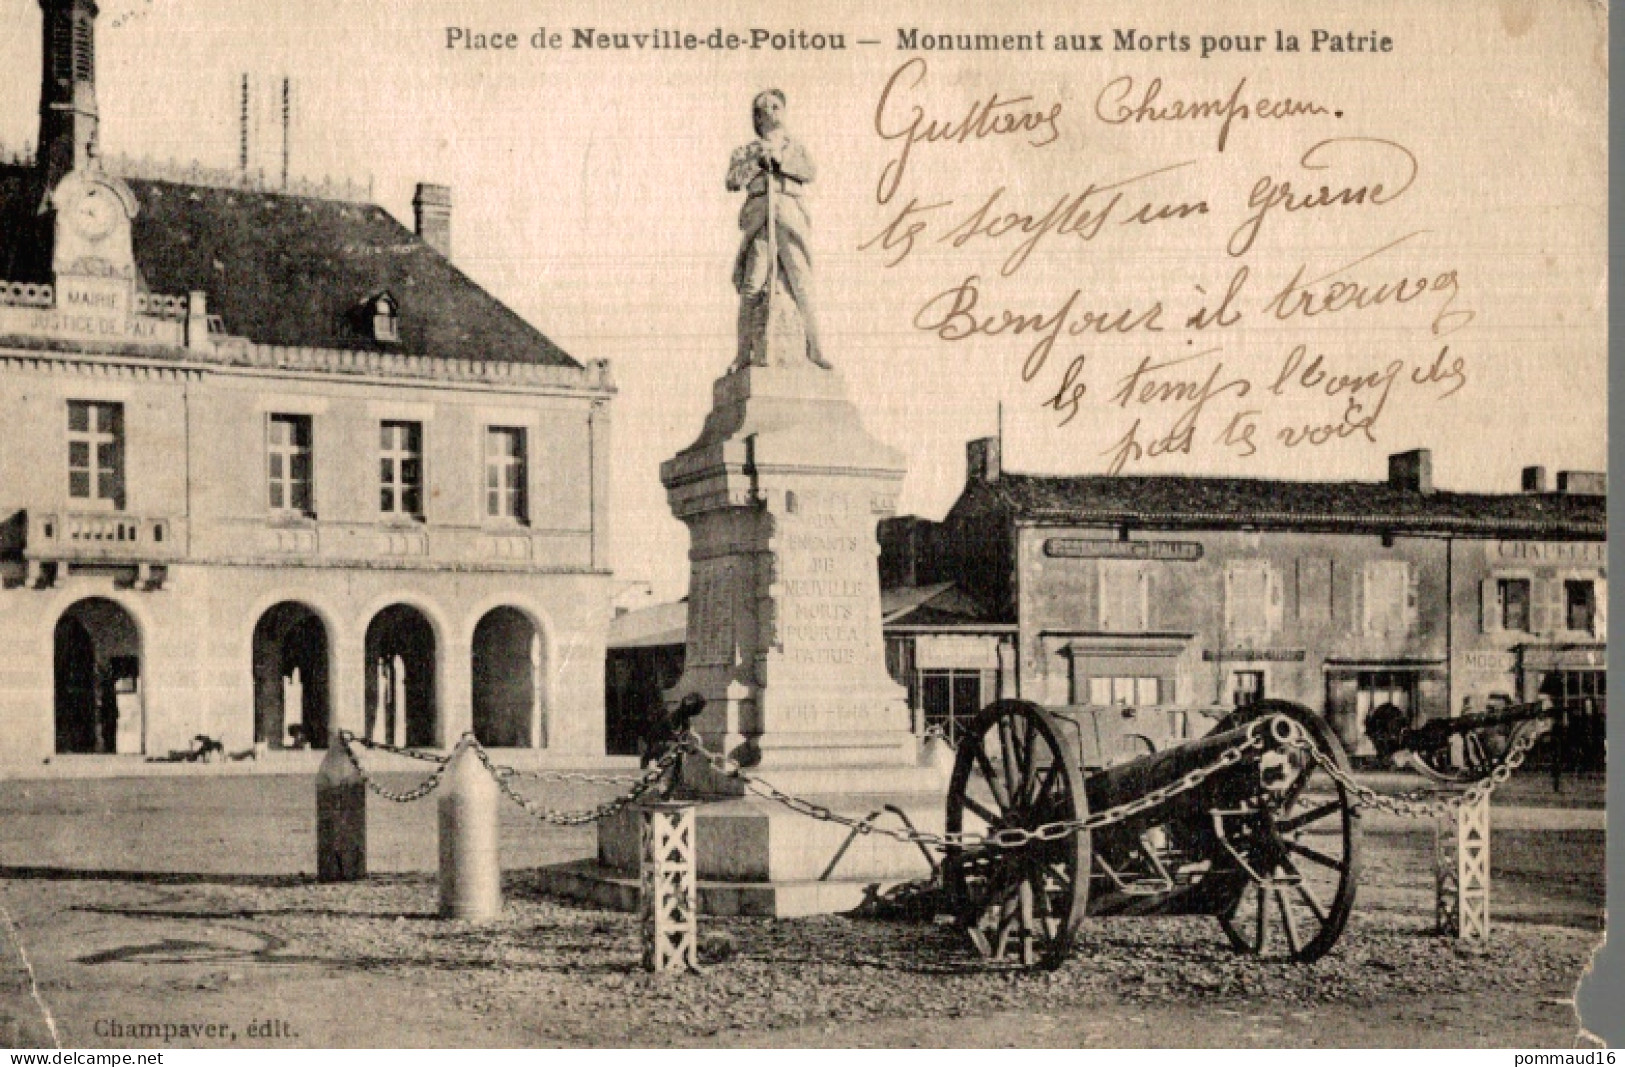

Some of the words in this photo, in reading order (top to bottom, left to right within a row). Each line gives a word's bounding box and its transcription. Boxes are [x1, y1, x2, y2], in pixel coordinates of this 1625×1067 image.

[445, 27, 518, 50] Place
[531, 28, 562, 50] de
[571, 28, 846, 51] Neuville-de-Poitou
[896, 28, 1044, 51] Monument
[1054, 34, 1104, 51] aux
[1113, 28, 1191, 52] Morts
[1202, 34, 1268, 57] pour
[1276, 29, 1300, 52] la
[1311, 29, 1394, 53] Patrie
[1117, 199, 1209, 225] un
[67, 291, 118, 308] MAIRIE
[30, 314, 95, 334] JUSTICE
[98, 318, 118, 335] DE
[125, 320, 157, 337] PAIX
[914, 276, 1167, 381] Bonjour
[1109, 350, 1251, 438] temps
[784, 580, 864, 598] NEUVILLE
[795, 603, 853, 620] MORTS
[795, 648, 855, 664] PATRIE
[93, 1019, 237, 1043] Champaver,
[246, 1018, 300, 1038] édit.
